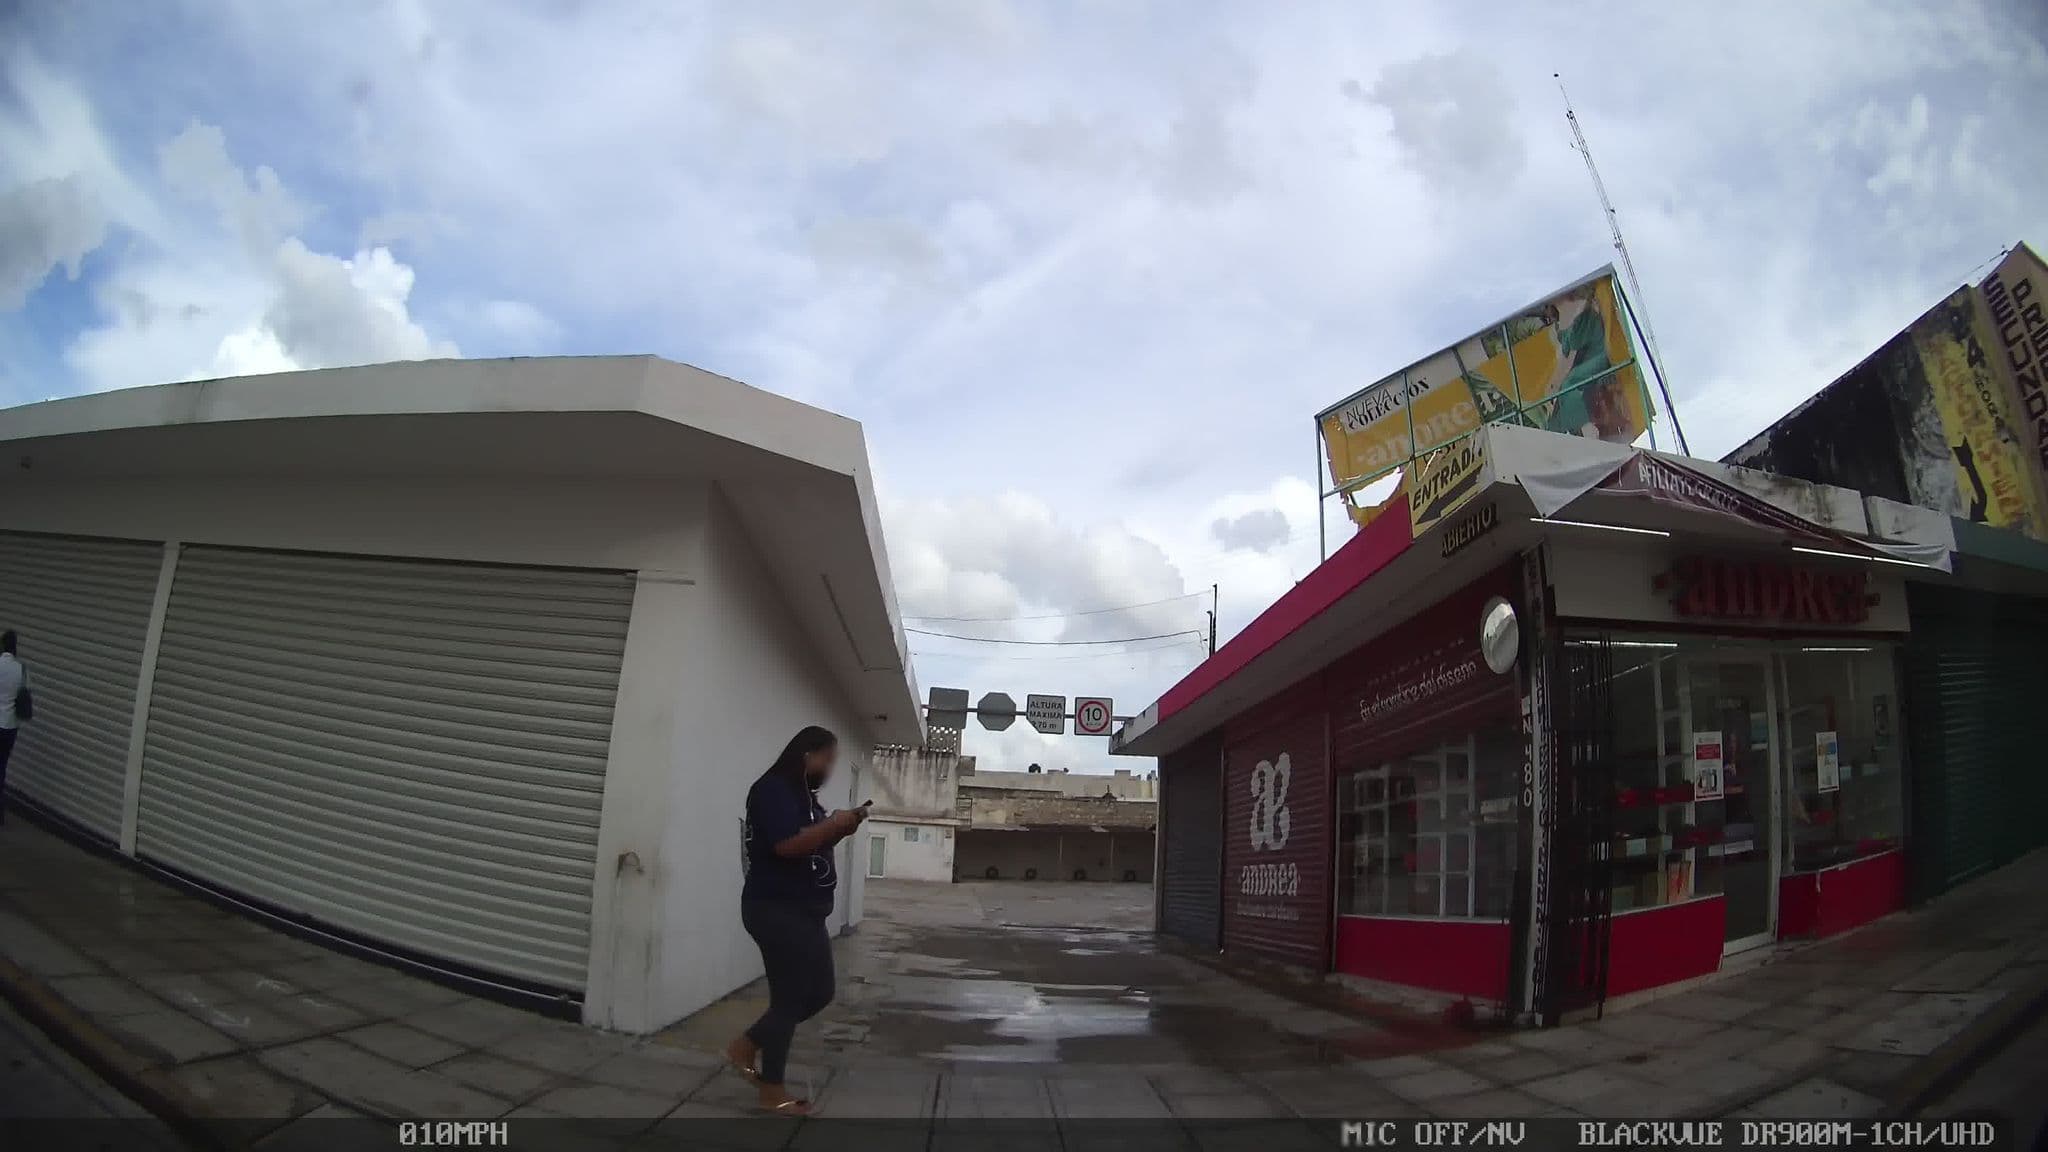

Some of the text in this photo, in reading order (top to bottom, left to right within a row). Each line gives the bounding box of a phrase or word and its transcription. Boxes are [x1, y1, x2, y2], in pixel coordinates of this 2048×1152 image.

[1346, 388, 1394, 423] NUEVA
[1030, 701, 1063, 710] ALTURA
[1085, 707, 1102, 721] 10
[1240, 862, 1298, 897] andrea
